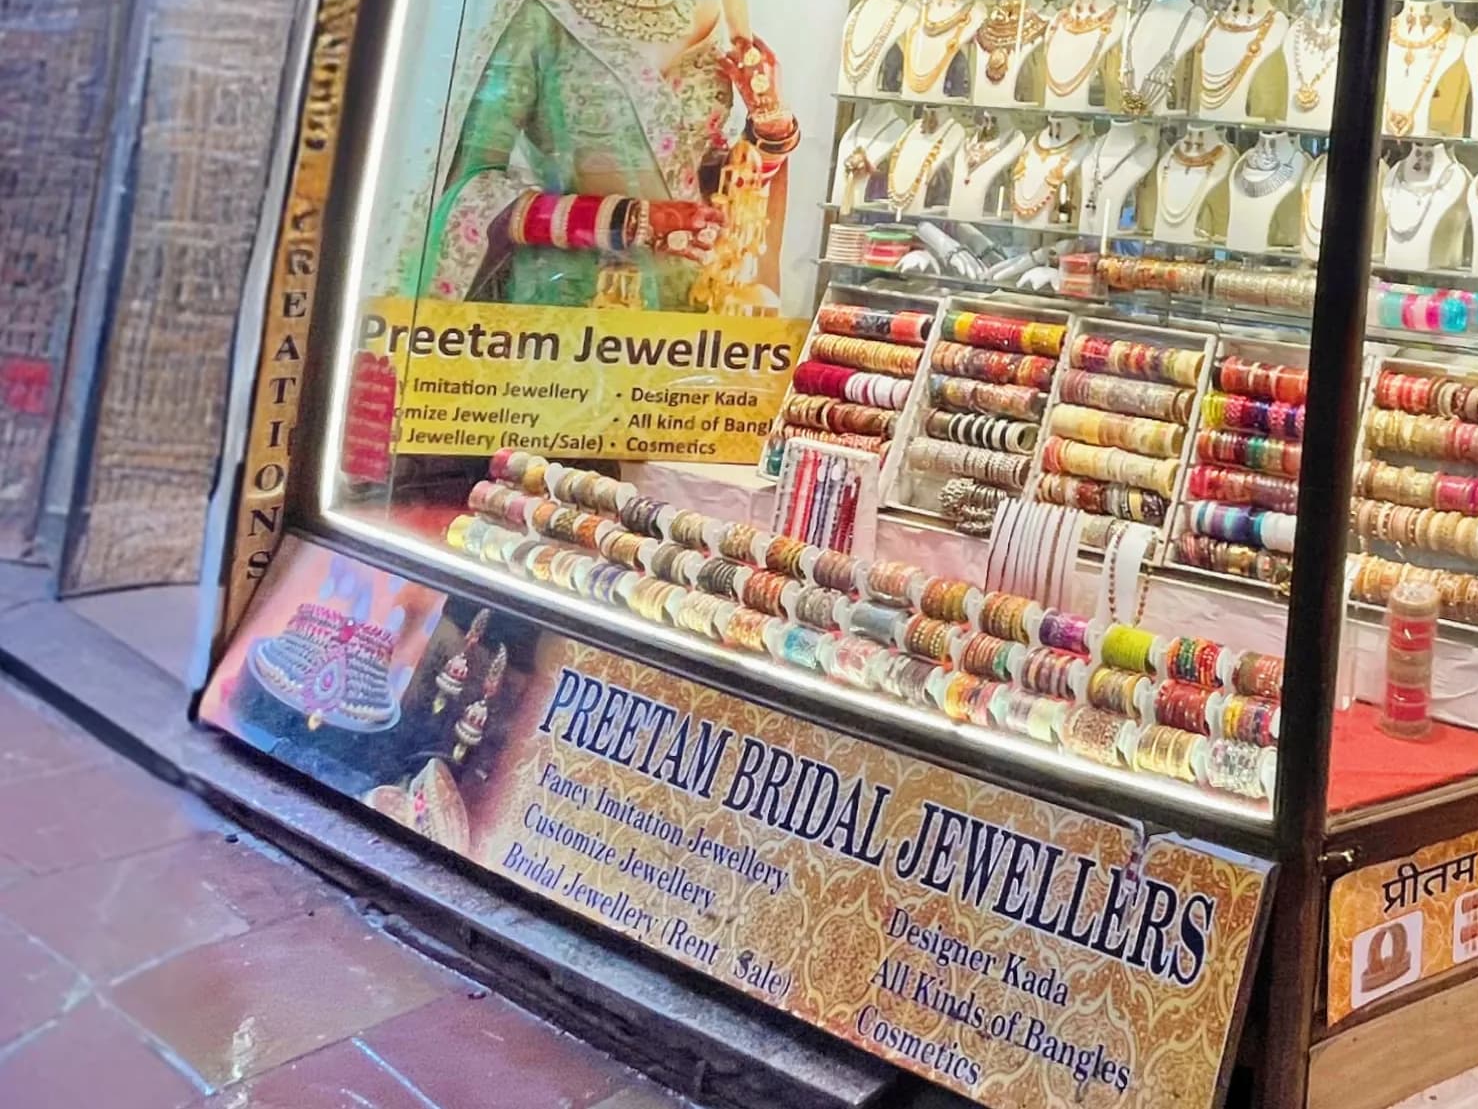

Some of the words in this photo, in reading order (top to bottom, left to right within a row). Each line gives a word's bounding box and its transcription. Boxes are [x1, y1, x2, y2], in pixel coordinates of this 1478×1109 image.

[359, 313, 558, 361] Preetam
[573, 326, 792, 371] Jewellers
[413, 377, 498, 397] Imitation
[502, 382, 589, 404] Jewellery
[452, 405, 540, 428] Jewellery
[631, 386, 710, 407] Designer
[715, 390, 758, 408] Kada
[407, 427, 496, 450] Jewellery
[500, 433, 604, 454] (Rent/Sale)
[626, 436, 717, 455] Cosmetics
[627, 413, 652, 429] All
[657, 414, 696, 430] kind
[701, 416, 720, 432] of
[724, 417, 774, 437] Bangl
[536, 763, 591, 808] Fancy
[594, 785, 683, 848] Imitation
[684, 818, 789, 895] Jewellery
[538, 668, 733, 799] PREETAM
[722, 741, 893, 866] BRIDAL
[897, 802, 1215, 986] JEWELLERS
[523, 804, 617, 867] Customize
[618, 847, 717, 915] Jewellery
[1382, 852, 1478, 912] प्रीतम
[501, 843, 564, 889] Bridal
[561, 872, 659, 940] Jewellery
[886, 906, 998, 978] Designer
[1001, 952, 1070, 1007] Kada
[855, 1004, 983, 1089] Cosmetics
[869, 956, 909, 999] All
[901, 972, 987, 1030] Kinds
[990, 1004, 1024, 1042] of
[1021, 1018, 1131, 1094] Bangles
